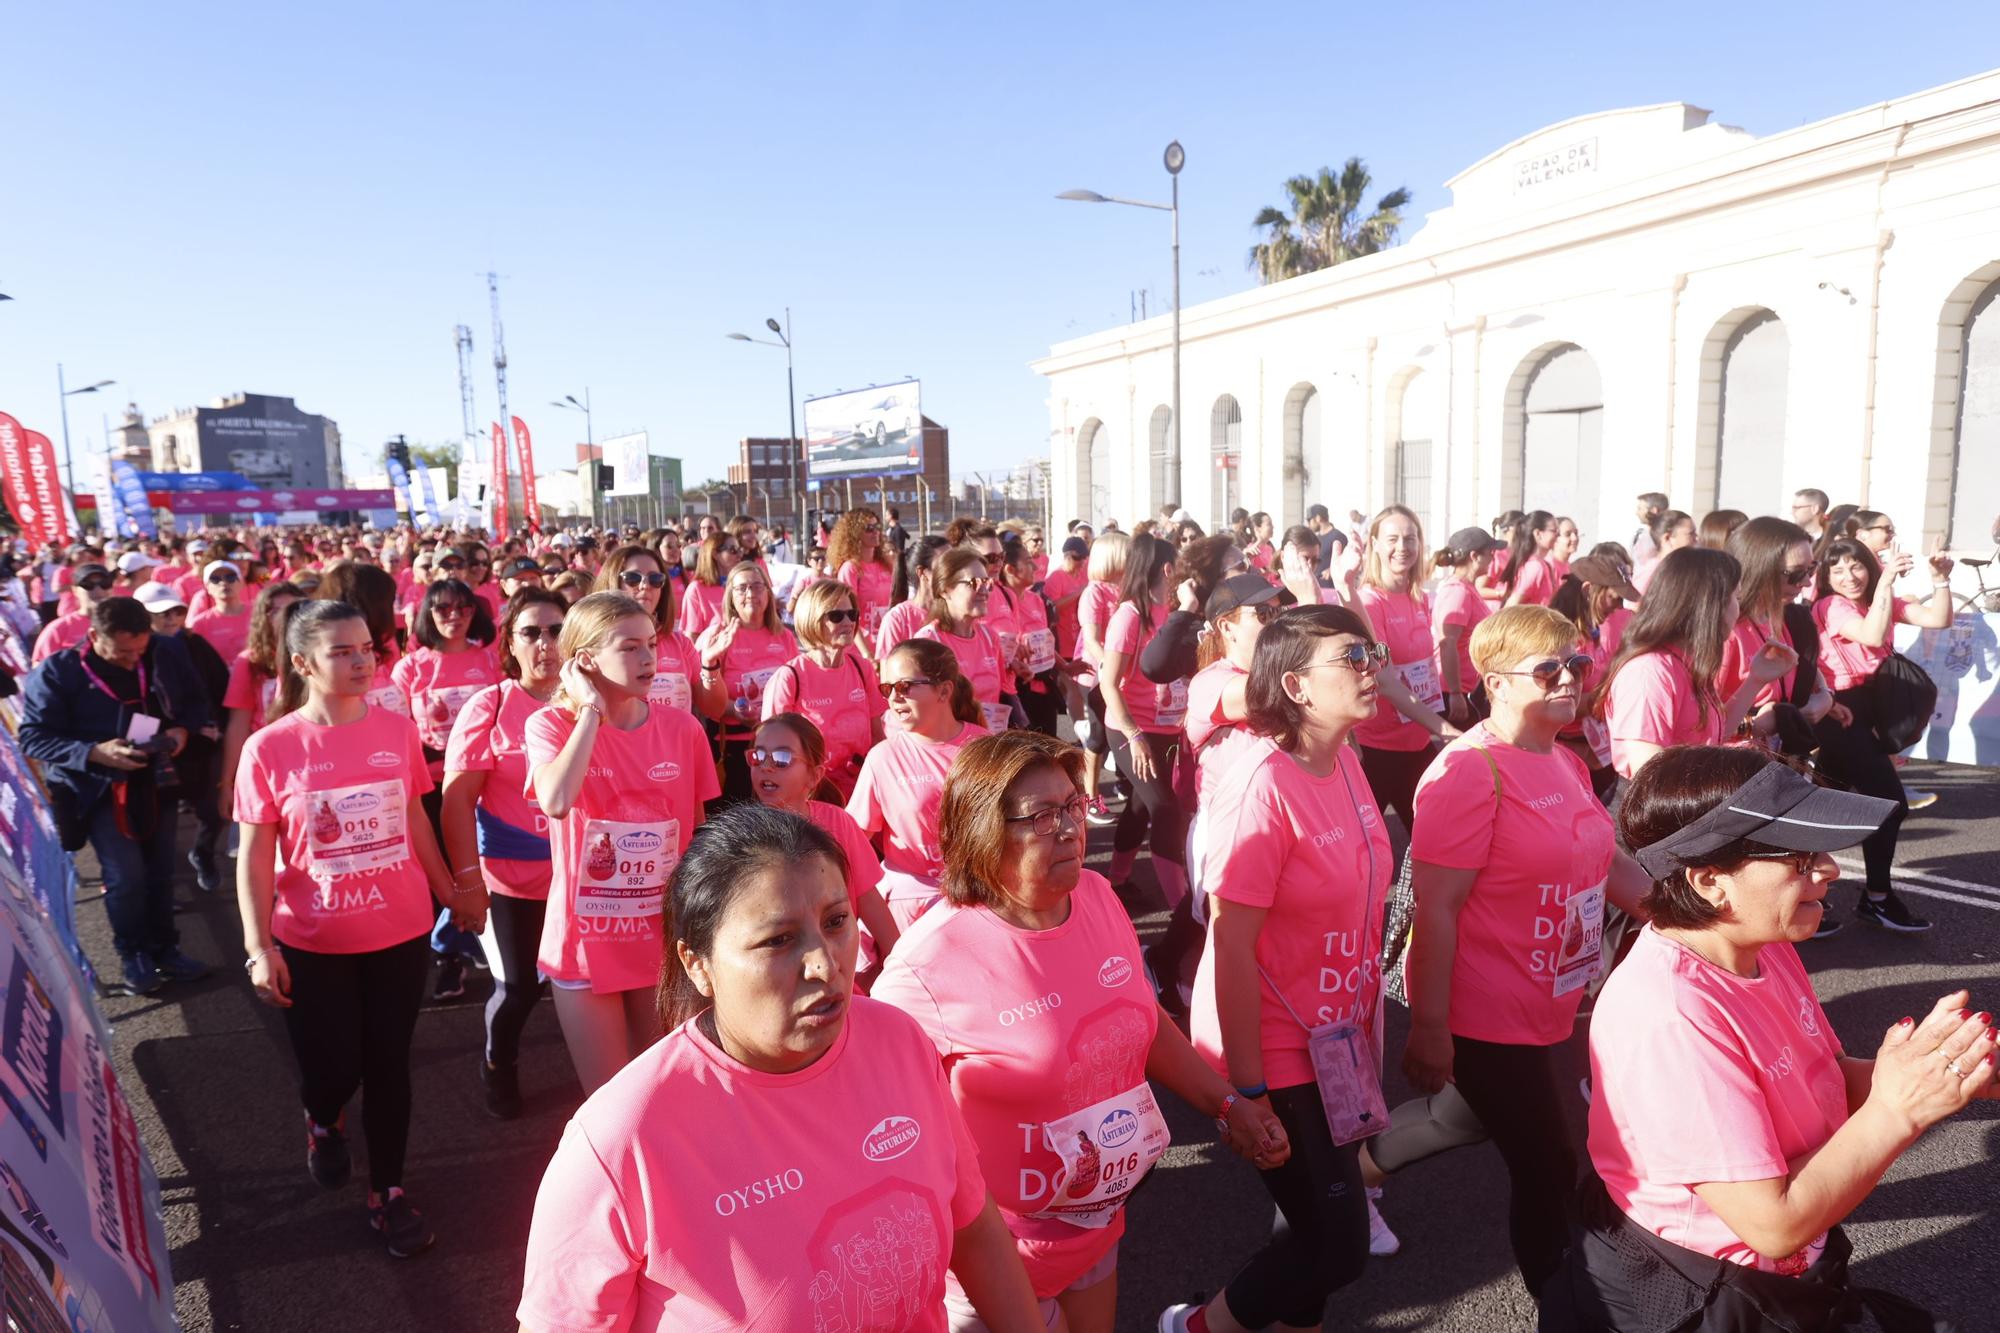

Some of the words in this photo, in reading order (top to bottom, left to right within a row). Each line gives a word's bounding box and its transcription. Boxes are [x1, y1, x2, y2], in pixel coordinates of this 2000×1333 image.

[1568, 144, 1588, 160] DE
[1518, 158, 1591, 188] VALENCIA
[344, 817, 379, 833] 016
[621, 839, 659, 848] ASTURIANA
[619, 860, 655, 874] 016
[590, 888, 621, 896] CARRERA
[633, 888, 641, 896] LA
[627, 876, 645, 886] 892
[311, 884, 385, 911] SUMA
[585, 902, 621, 911] OYSHO
[1323, 929, 1357, 957] TU
[1101, 963, 1132, 985] ASTURIANA
[999, 992, 1062, 1028] OYSHO
[869, 1126, 918, 1158] ASTURIANA
[1102, 1121, 1136, 1143] ASTURIANA
[1102, 1152, 1139, 1182] 016
[714, 1168, 805, 1217] OYSHO
[1105, 1178, 1129, 1196] 4083
